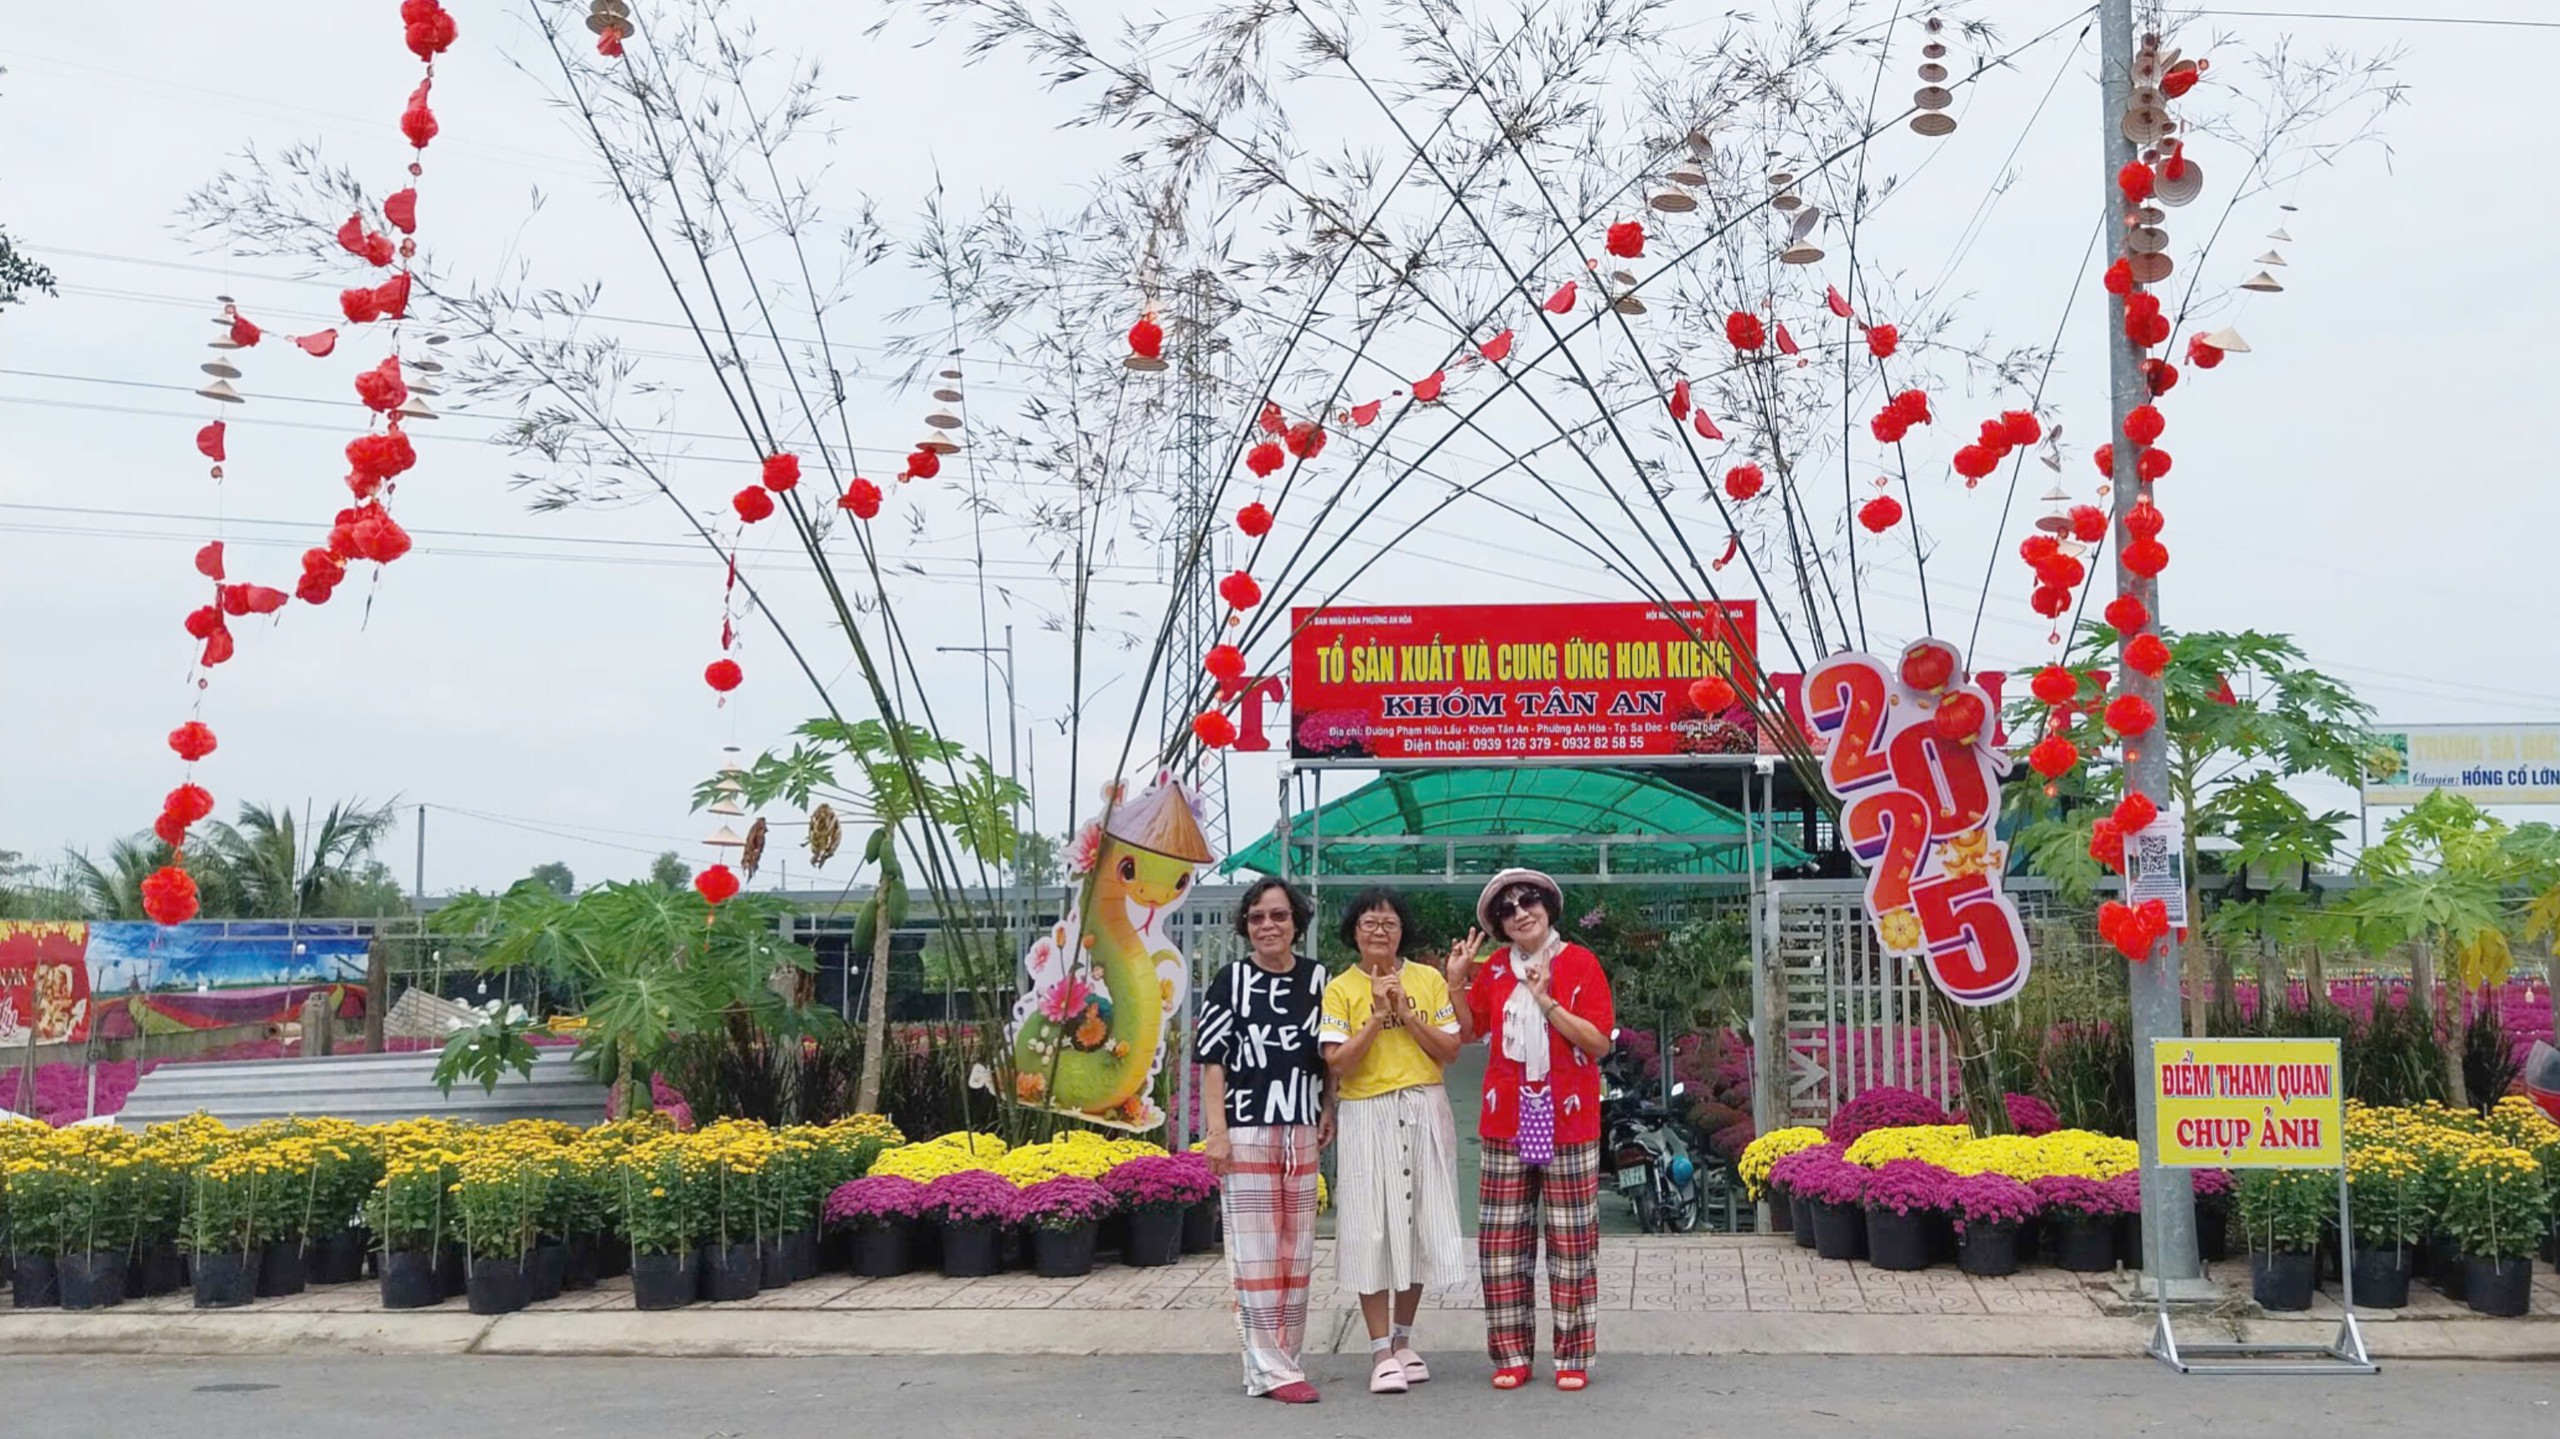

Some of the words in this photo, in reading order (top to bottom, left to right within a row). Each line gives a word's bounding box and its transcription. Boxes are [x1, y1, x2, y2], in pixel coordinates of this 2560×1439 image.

[1317, 633, 1345, 684] TỔ
[1351, 637, 1395, 684] SẢN
[1401, 632, 1456, 683] XUẤT
[1461, 638, 1492, 682] VÀ
[1497, 642, 1558, 682] CUNG
[1564, 636, 1609, 680] ỨNG
[1616, 640, 1661, 679] HOA
[1382, 686, 1506, 719] KHÓM
[1515, 685, 1599, 718] TÂN
[1608, 690, 1667, 716] AN
[1404, 738, 1432, 754] Điện
[1435, 738, 1470, 753] thoại:
[1473, 738, 1502, 751] 0939
[1505, 737, 1526, 750] 126
[1529, 737, 1551, 749] 379
[1562, 736, 1590, 749] 0932
[1594, 736, 1608, 749] 82
[1612, 736, 1626, 749] 58
[1630, 736, 1644, 748] 55
[1497, 723, 1514, 734] Tân
[1517, 723, 1529, 734] An
[1574, 723, 1586, 733] An
[1631, 722, 1643, 732] Sa
[2508, 763, 2527, 786] CỔ
[2161, 1050, 2214, 1097] ĐIỂM
[2215, 1064, 2274, 1098] THAM
[2277, 1064, 2331, 1103] QUAN
[2176, 1118, 2253, 1156] CHỤP
[2260, 1105, 2320, 1148] ẢNH
